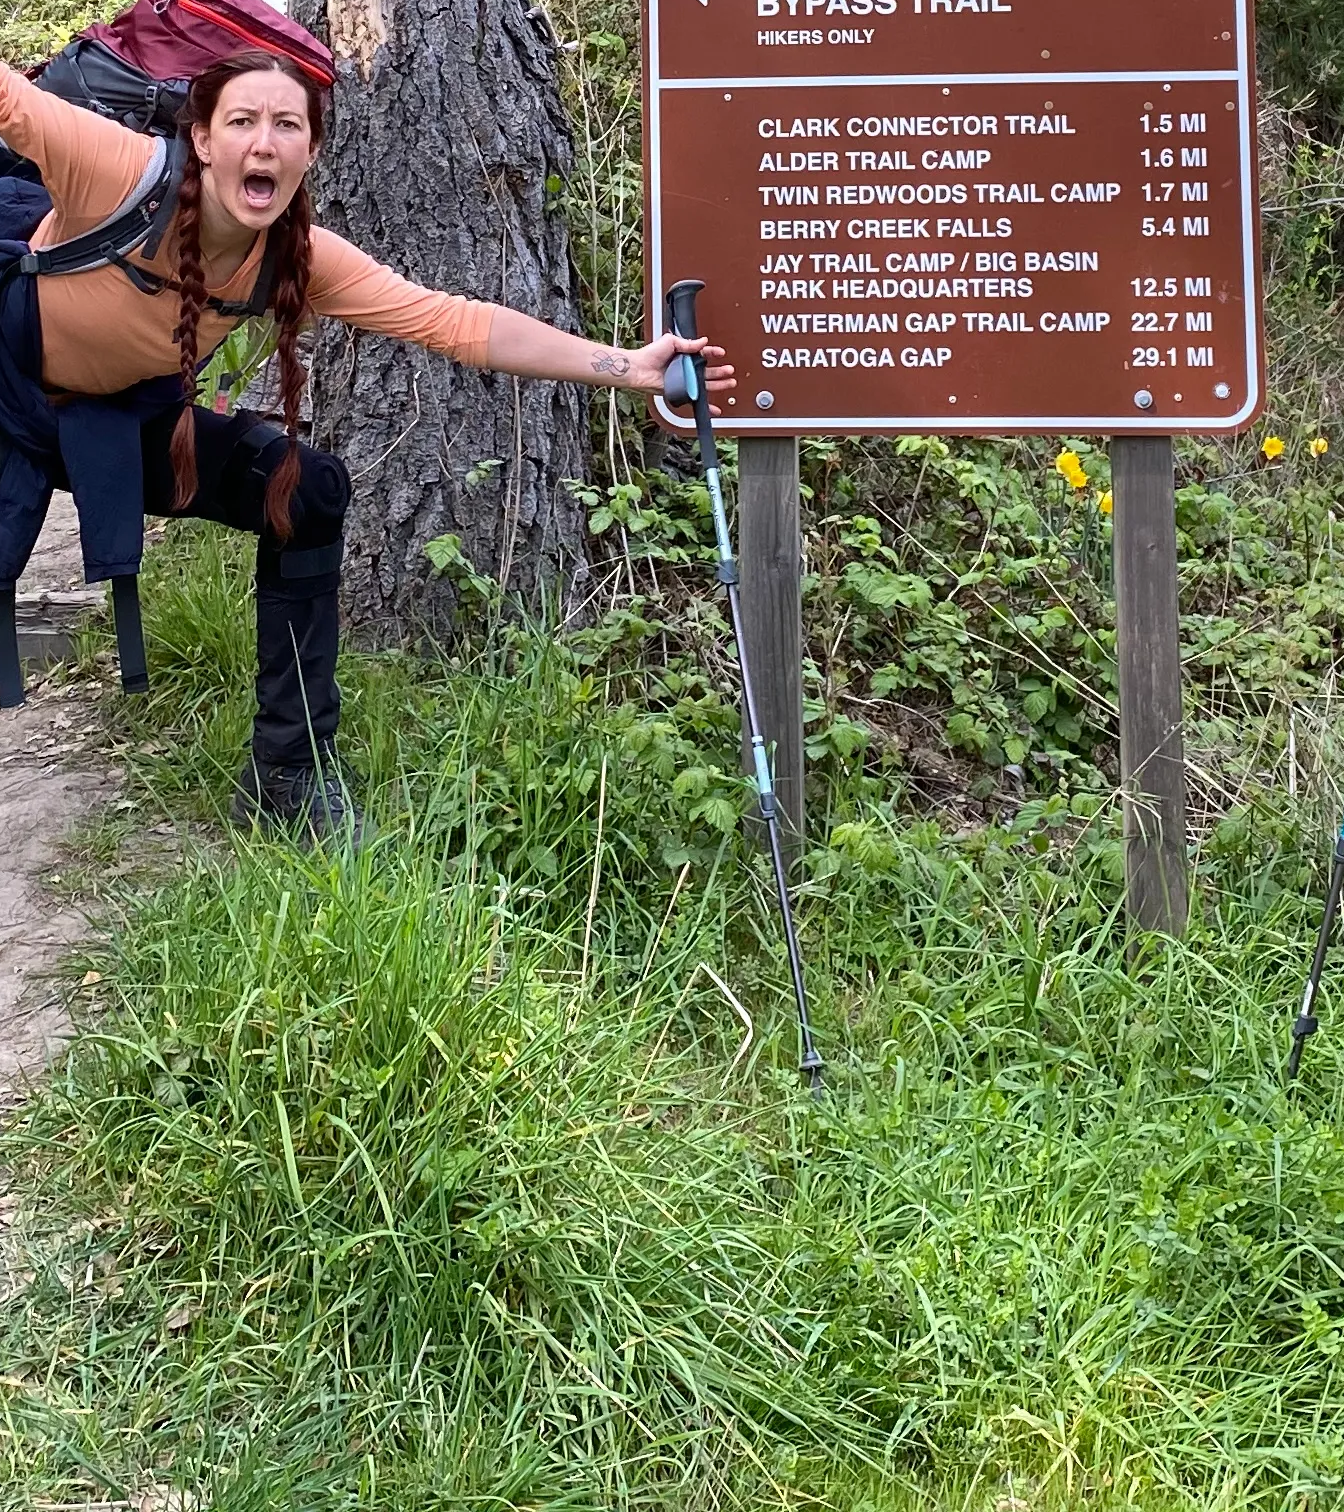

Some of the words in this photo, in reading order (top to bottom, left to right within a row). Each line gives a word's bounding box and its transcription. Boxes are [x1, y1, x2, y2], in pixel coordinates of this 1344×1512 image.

[757, 29, 824, 46] HIKERS
[827, 28, 875, 45] ONLY
[758, 117, 841, 138] CLARK
[846, 115, 998, 137] CONNECTOR
[1004, 114, 1076, 135] TRAIL
[1139, 113, 1173, 134] 1.5
[1179, 113, 1207, 133] MI
[758, 151, 840, 172] ALDER
[844, 150, 916, 171] TRAIL
[921, 149, 991, 170] CAMP
[1140, 147, 1174, 168] 1.6
[1180, 147, 1208, 167] MI
[758, 185, 819, 206] TWIN
[825, 183, 968, 205] REDWOODS
[972, 183, 1045, 204] TRAIL
[1050, 182, 1121, 203] CAMP
[1141, 182, 1175, 202] 1.7
[1181, 181, 1208, 202] MI
[760, 219, 842, 240] BERRY
[847, 218, 931, 239] CREEK
[936, 217, 1013, 238] FALLS
[1141, 217, 1177, 237] 5.4
[1182, 216, 1210, 237] MI
[759, 254, 804, 274] JAY
[808, 253, 880, 274] TRAIL
[885, 252, 955, 273] CAMP
[959, 251, 970, 272] /
[975, 251, 1017, 272] BIG
[1024, 251, 1099, 272] BASIN
[761, 279, 826, 300] PARK
[832, 277, 1034, 299] HEADQUARTERS
[1130, 277, 1178, 298] 12.5
[1184, 277, 1212, 297] MI
[760, 312, 899, 334] WATERMAN
[904, 312, 957, 333] GAP
[961, 312, 1034, 333] TRAIL
[1039, 311, 1111, 333] CAMP
[1131, 312, 1179, 332] 22.7
[1185, 311, 1213, 332] MI
[761, 347, 896, 368] SARATOGA
[900, 347, 952, 368] GAP
[1132, 346, 1177, 367] 29.1
[1186, 346, 1214, 367] MI
